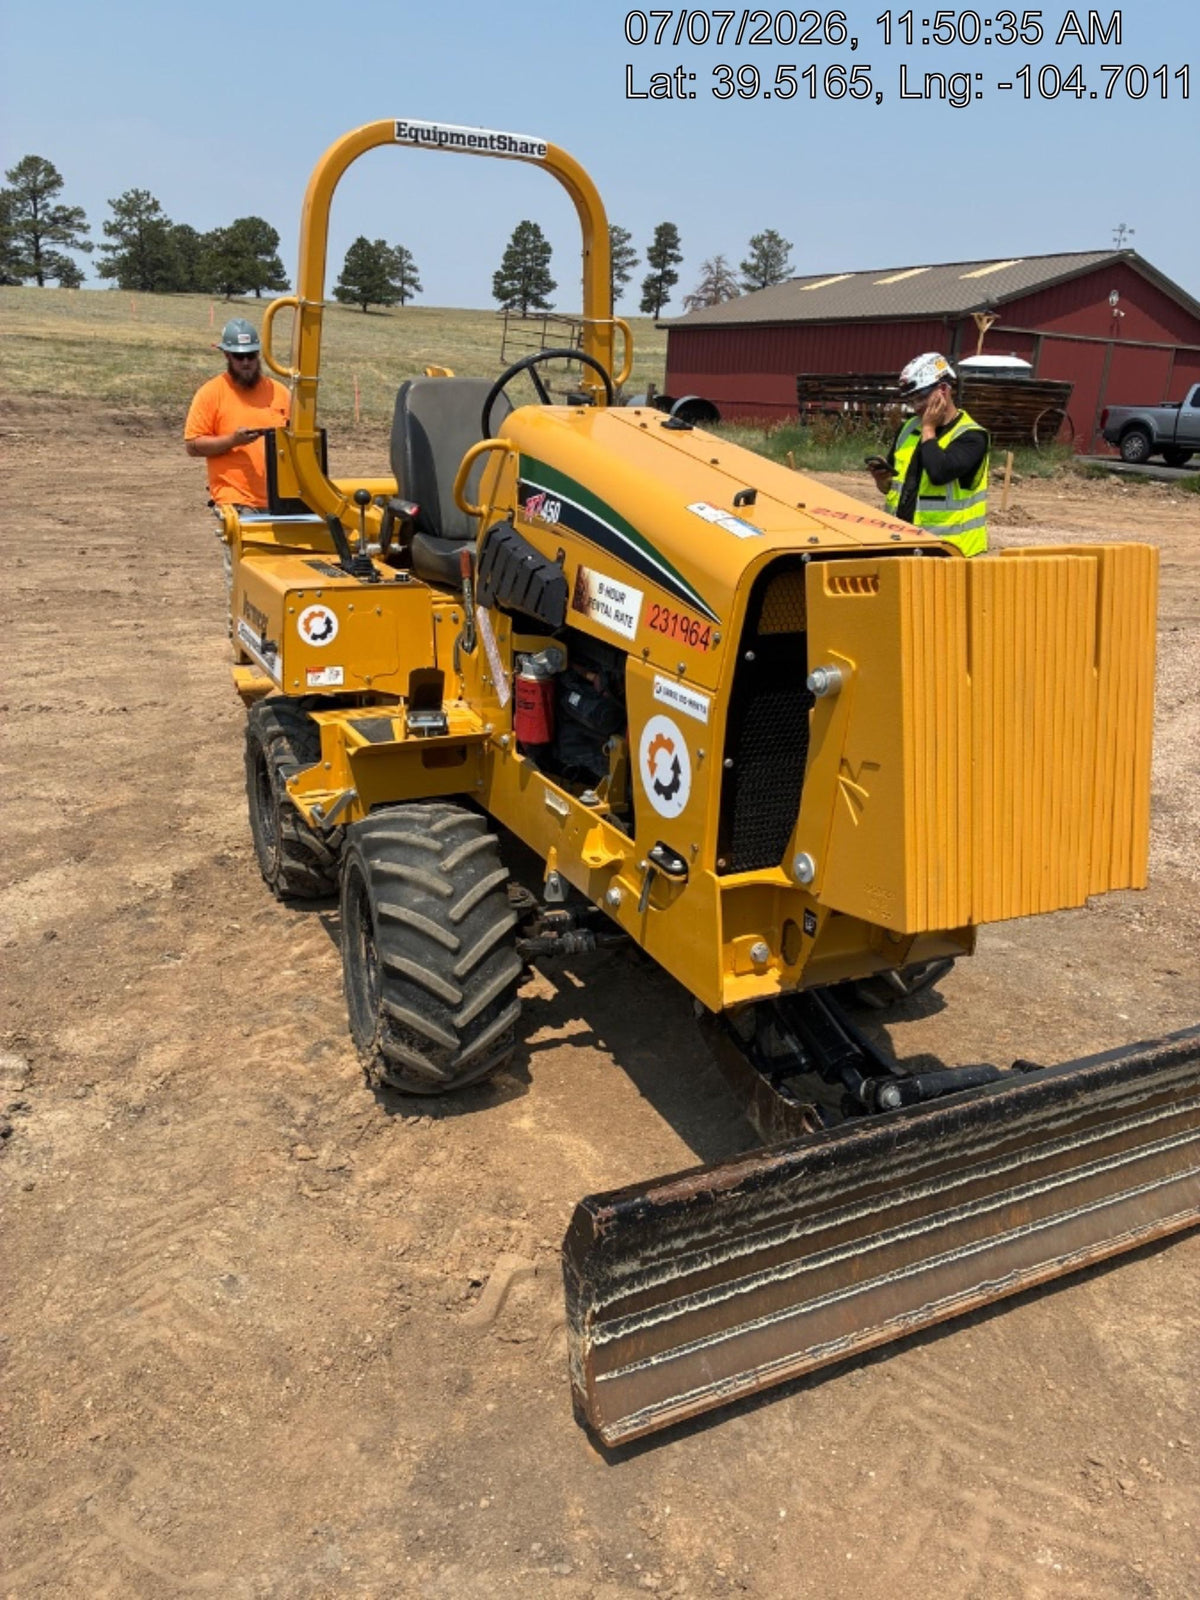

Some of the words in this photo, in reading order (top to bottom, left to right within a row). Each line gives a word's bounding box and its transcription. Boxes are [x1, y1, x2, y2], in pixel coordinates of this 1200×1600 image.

[395, 121, 547, 156] EquipmentShare
[605, 586, 626, 605] HOUR
[614, 609, 634, 629] RATE
[649, 603, 711, 651] 231964
